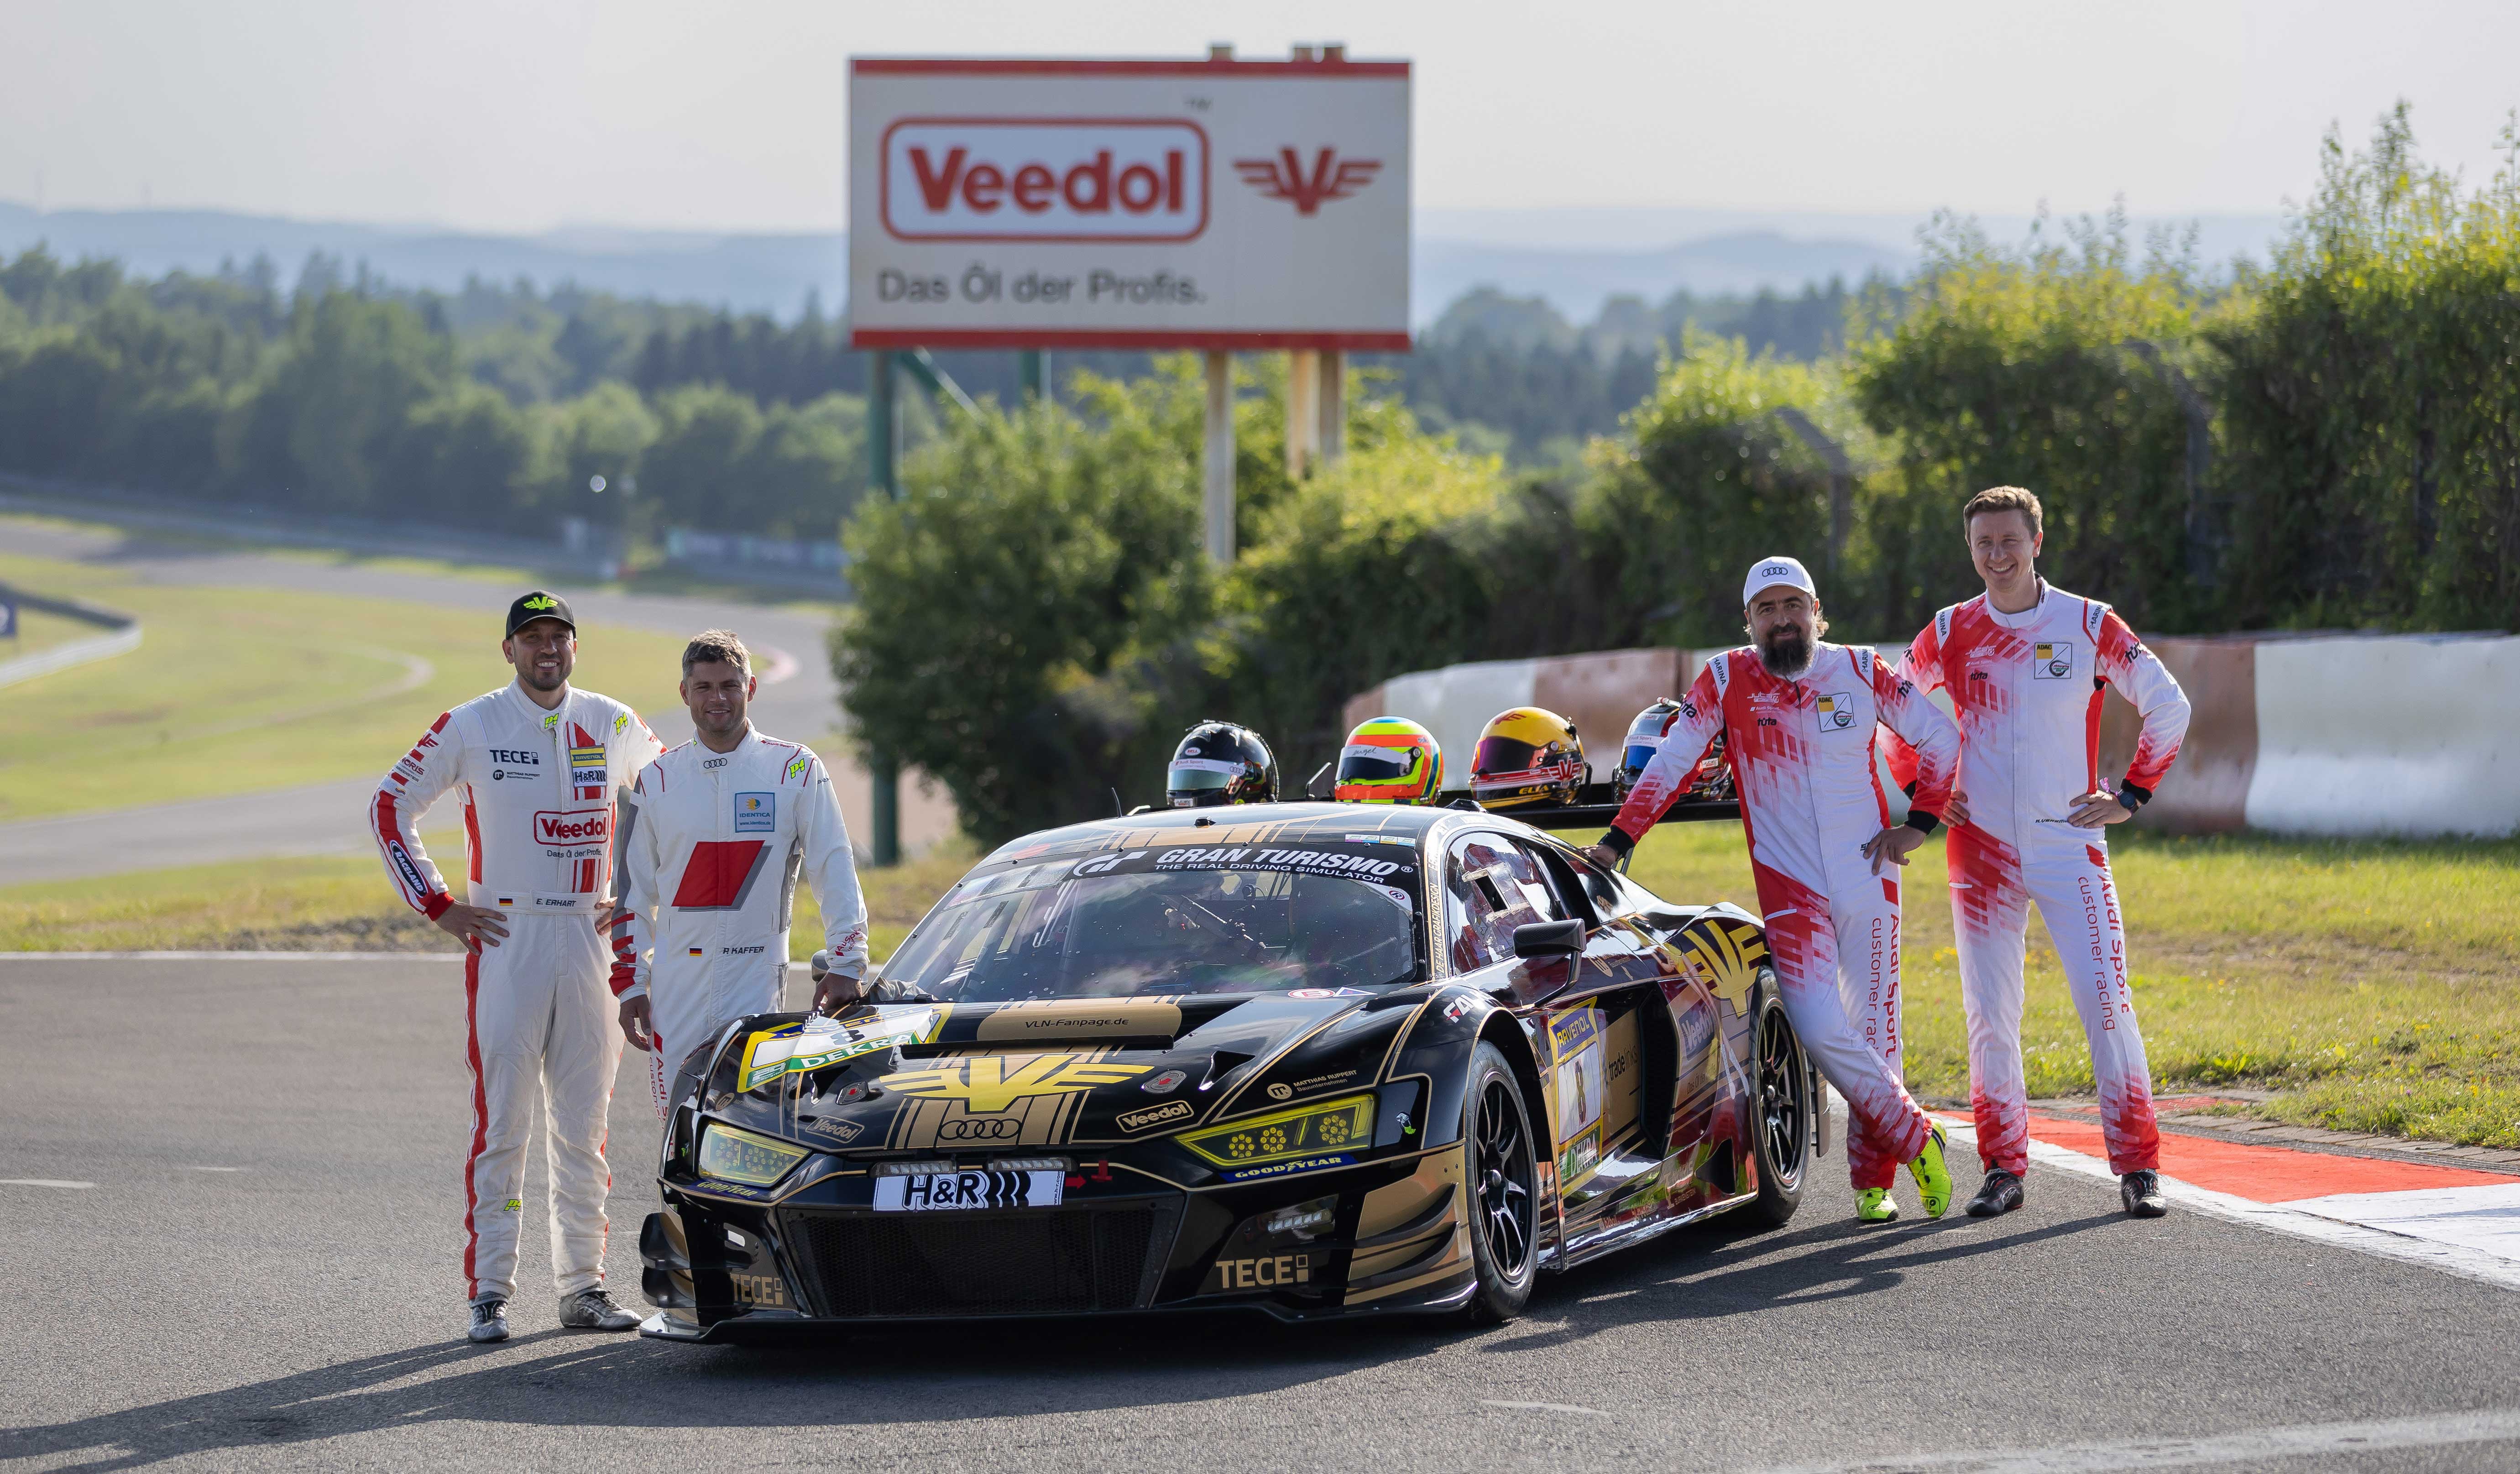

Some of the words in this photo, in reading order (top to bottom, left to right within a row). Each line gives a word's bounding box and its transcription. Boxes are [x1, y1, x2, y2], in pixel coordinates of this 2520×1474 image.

[906, 146, 1185, 215] Veedol
[876, 267, 951, 305] Das
[959, 258, 1001, 304] Öl
[1010, 267, 1073, 304] der
[1087, 267, 1208, 306] Profis.
[490, 749, 531, 765] TECE
[575, 770, 597, 783] H&R
[540, 817, 606, 839] Veedol
[395, 850, 424, 892] RACELAND
[1156, 848, 1253, 864] GRAN
[1253, 848, 1399, 876] TURISMO
[1295, 867, 1385, 883] SIMULATOR
[546, 899, 577, 907] ERHART
[1429, 883, 1442, 936] GRAFIKDESIGN
[2101, 881, 2121, 931] Audi
[731, 946, 765, 955] KAFFER
[1433, 938, 1443, 961] HAAR
[1890, 914, 1899, 975] Audi
[2078, 876, 2103, 965] customer
[2095, 971, 2116, 1031] racing
[1436, 960, 1445, 973] DE
[1868, 917, 1882, 1011] customer
[1025, 1018, 1129, 1029] VLN-Fanpage.de
[1557, 1015, 1590, 1048] RAVENOL
[1682, 1007, 1715, 1050] Veedol
[1884, 982, 1898, 1058] Sport
[800, 1034, 913, 1069] DEKRA
[1608, 1045, 1638, 1082] tradelinks
[656, 1056, 668, 1101] Audi
[1293, 1076, 1326, 1087] MATTHIAS
[1328, 1070, 1357, 1080] RUPPERT
[1297, 1078, 1348, 1092] Bauunternehmen
[813, 1119, 858, 1139] Veedol
[1122, 1104, 1188, 1127] Veedol
[1235, 1156, 1343, 1179] GOODYEAR
[697, 1181, 758, 1197] GOODYEAR
[903, 1172, 987, 1209] H&R
[1215, 1255, 1294, 1289] TECE
[730, 1273, 774, 1305] TECE
